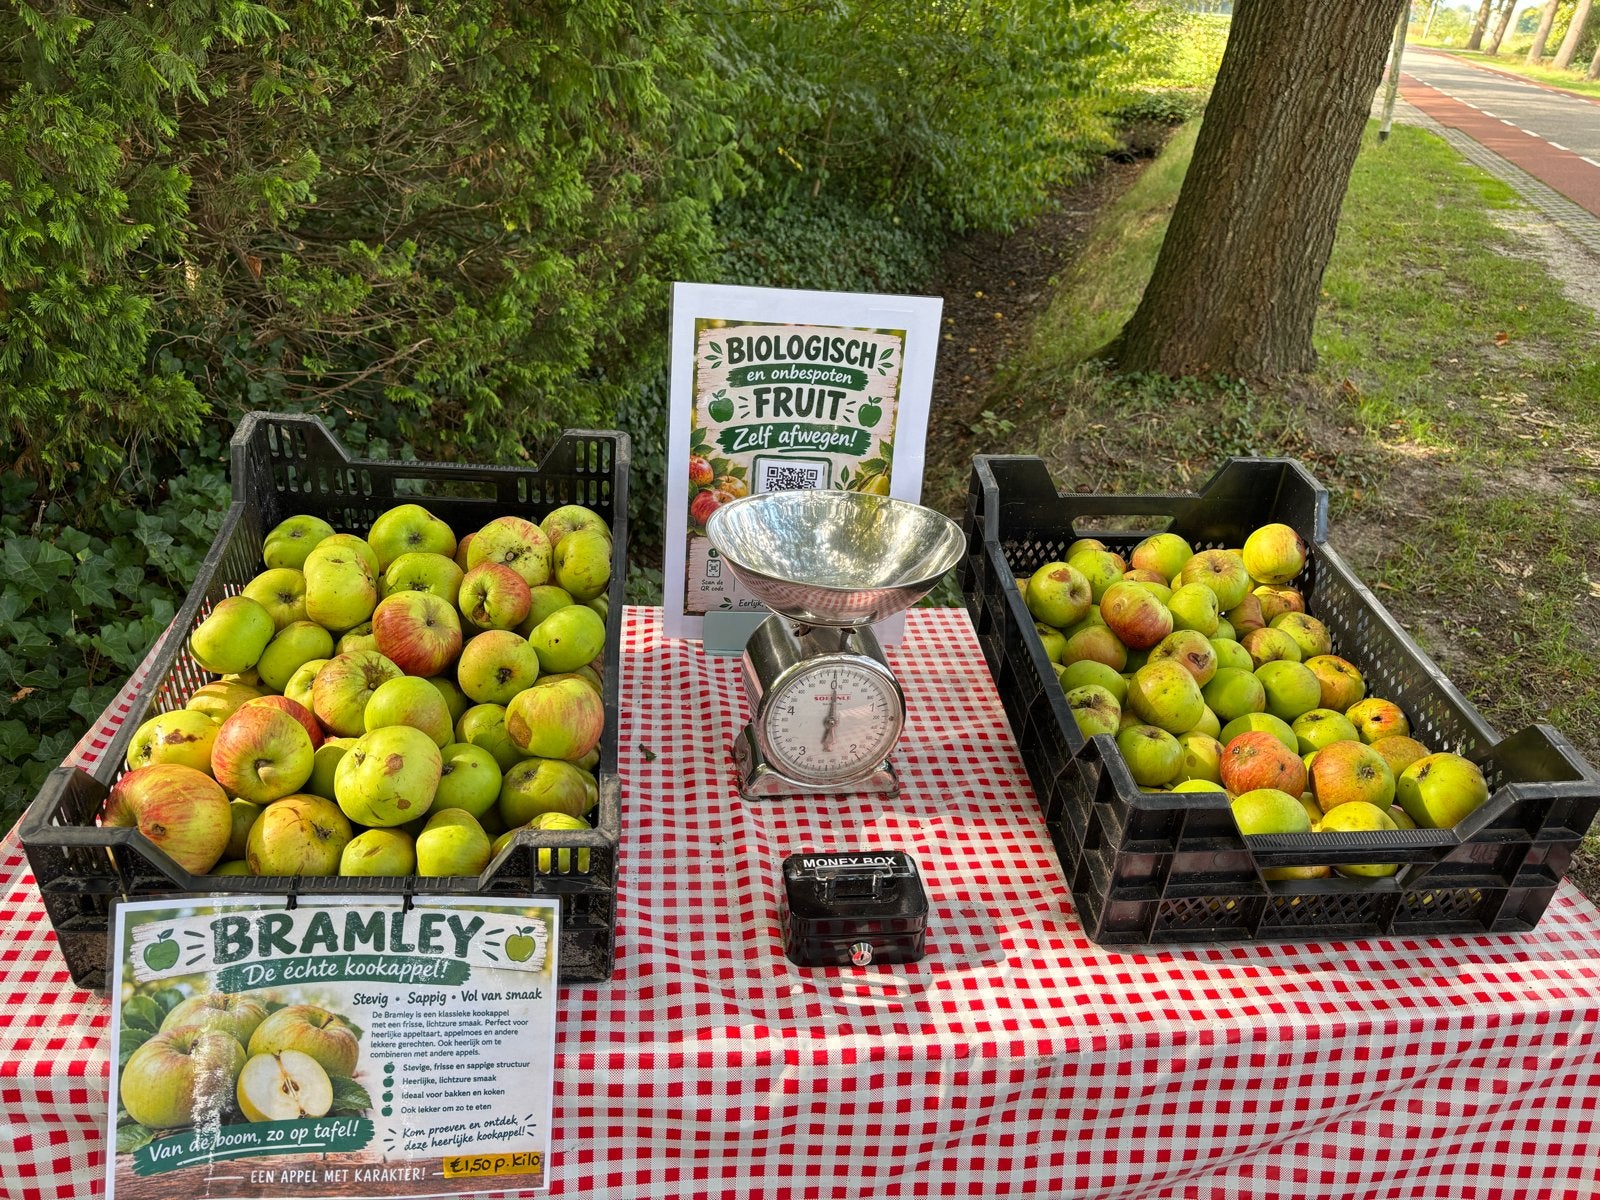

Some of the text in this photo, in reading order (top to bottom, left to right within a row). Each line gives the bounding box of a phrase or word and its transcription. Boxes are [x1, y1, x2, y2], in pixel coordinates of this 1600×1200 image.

[726, 334, 878, 368] BIOLOGISCH
[747, 364, 852, 385] en onbespoten
[753, 386, 847, 420] FRUIT
[733, 425, 858, 450] Zelf afwegen!
[787, 706, 795, 716] 4
[799, 746, 806, 755] 3
[850, 744, 857, 754] 2
[803, 856, 897, 868] MONEY BOX
[210, 911, 485, 964] BRAMLEY
[242, 957, 449, 986] De échte kookappel!
[352, 988, 543, 1009] Stevig Sappig Vol van smaak
[384, 1011, 414, 1020] Bramley
[472, 1010, 509, 1018] kookappel
[372, 1030, 401, 1039] heerlijke
[403, 1030, 442, 1038] appeltaart,
[444, 1029, 482, 1038] appelmoes
[398, 1040, 436, 1049] gerechten.
[454, 1039, 480, 1047] heerlijk
[403, 1064, 432, 1072] Stevige,
[466, 1062, 495, 1070] sappige
[402, 1078, 437, 1086] Heerlijke,
[402, 1115, 518, 1138] Kom proeven en ontdek,
[149, 1120, 358, 1162] Van de boom, zo op tafel!
[404, 1126, 525, 1151] deze heerlijke kookappel!
[450, 1158, 490, 1174] €1,50
[494, 1158, 509, 1172] p.
[251, 1168, 426, 1184] EEN APPEL MET KARAKTER!
